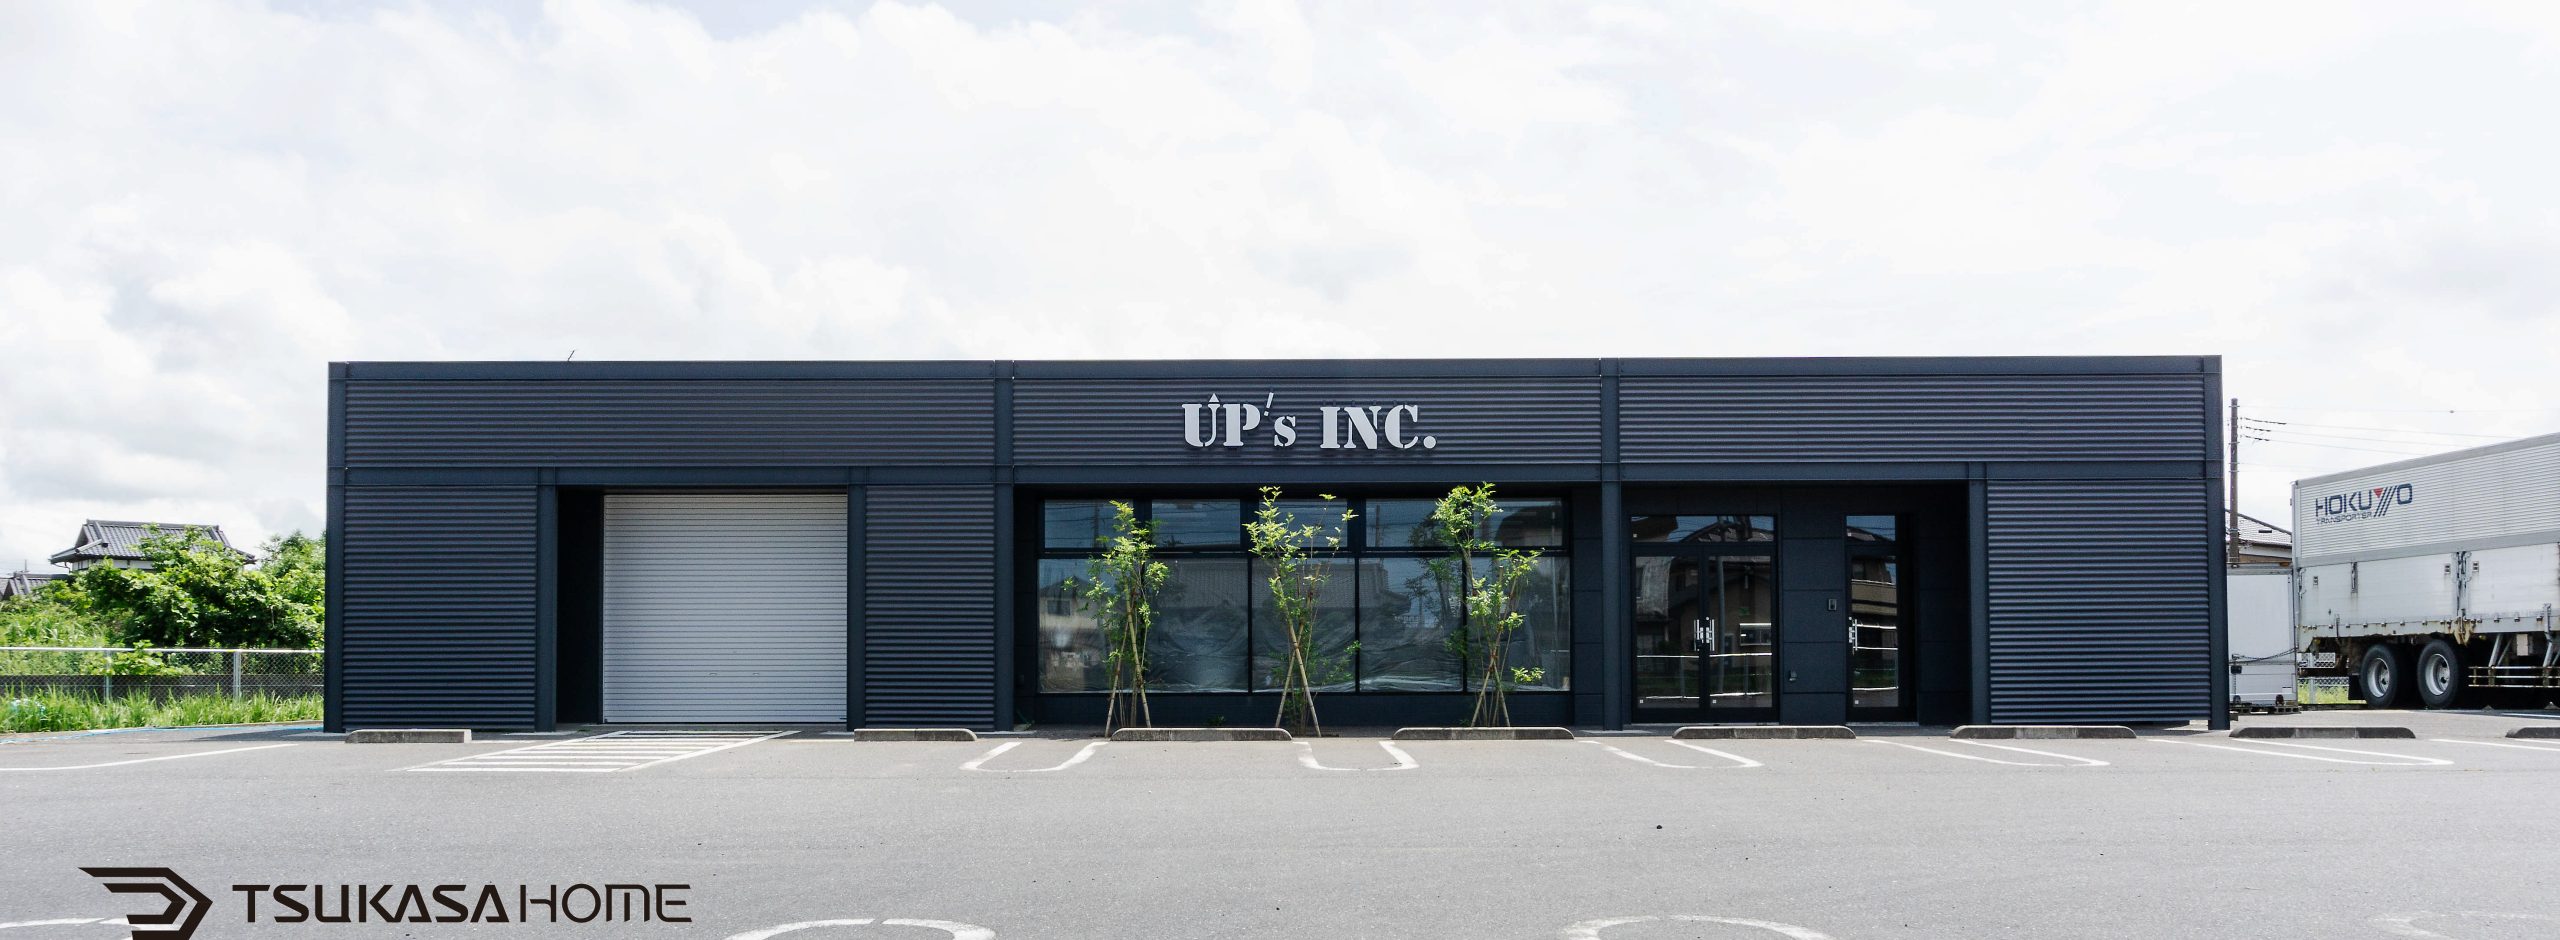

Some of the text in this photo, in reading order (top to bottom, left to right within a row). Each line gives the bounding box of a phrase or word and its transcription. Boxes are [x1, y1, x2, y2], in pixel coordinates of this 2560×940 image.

[1320, 404, 1437, 450] INC.
[2315, 483, 2413, 517] HOKUYO
[2316, 511, 2373, 525] TRANSPORTER
